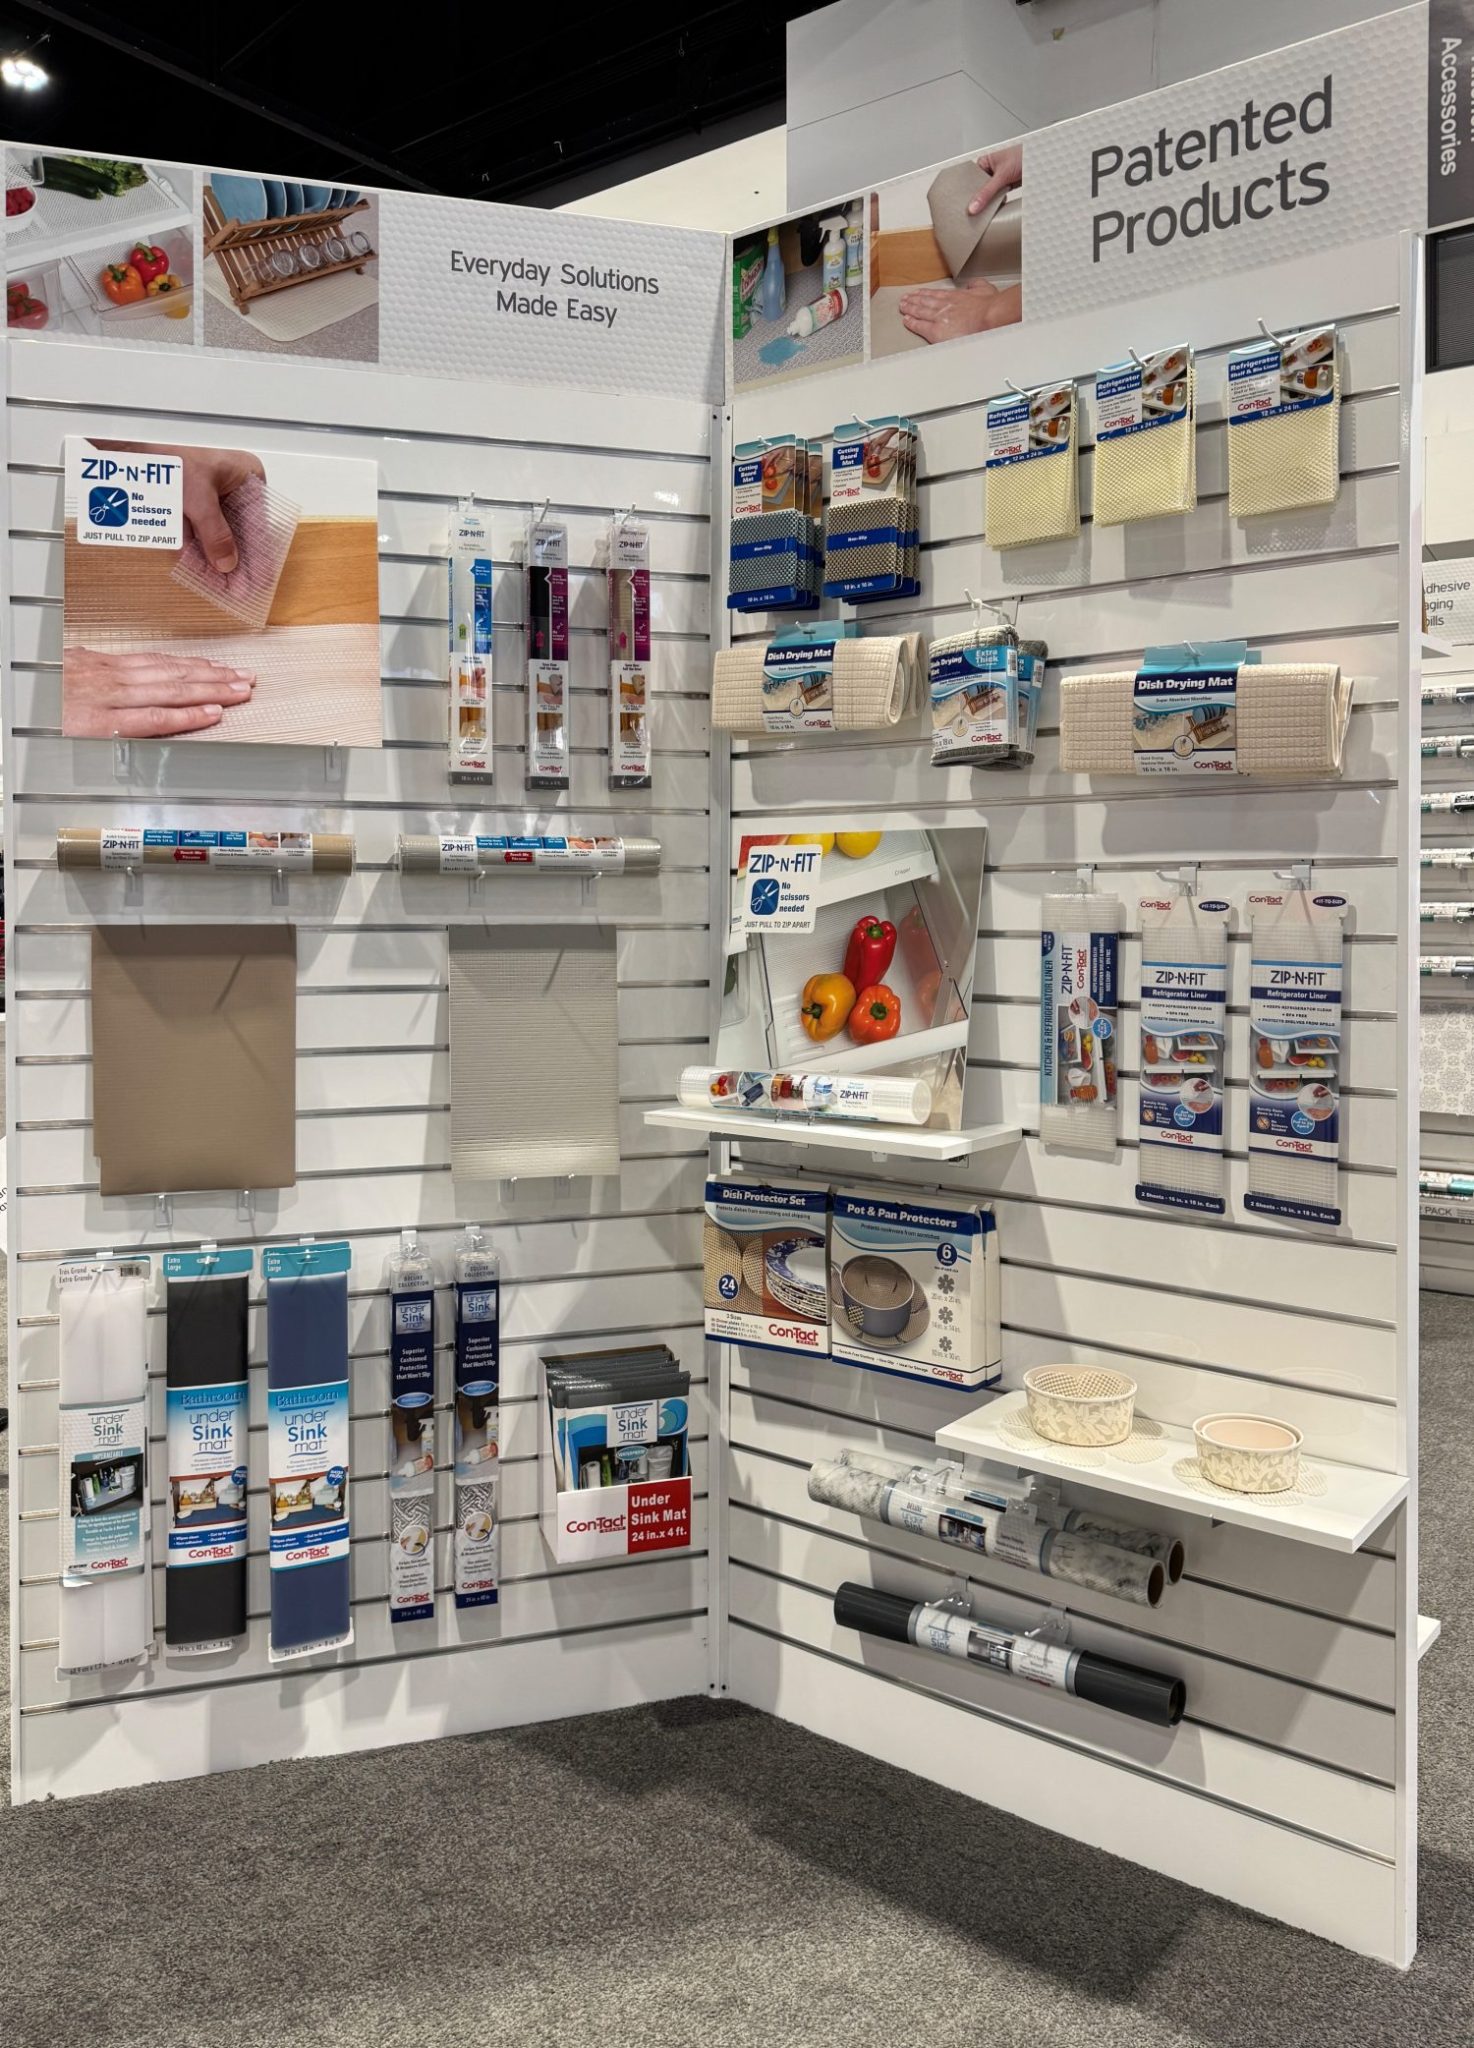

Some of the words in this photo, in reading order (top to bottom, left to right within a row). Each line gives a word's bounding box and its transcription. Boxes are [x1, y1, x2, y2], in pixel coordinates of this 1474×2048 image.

[1441, 37, 1462, 176] Accessories
[1091, 74, 1332, 198] Patented
[1093, 160, 1329, 263] Products
[451, 250, 550, 286] Everyday
[561, 264, 659, 294] Solutions
[497, 290, 557, 316] Made
[567, 299, 617, 328] Easy
[1231, 355, 1279, 371] Refrigerator
[1097, 374, 1140, 390] Refrigerator
[988, 407, 1028, 420] Refrigerator
[837, 447, 859, 455] Cutting
[840, 453, 858, 461] Board
[81, 458, 175, 484] ZIP-N-FIT
[738, 464, 758, 472] Cutting
[131, 492, 144, 500] No
[131, 505, 172, 515] scissors
[131, 518, 166, 526] needed
[105, 533, 124, 541] PULL
[151, 536, 177, 544] APART
[767, 652, 785, 660] Dish
[786, 650, 813, 660] Drying
[814, 649, 832, 658] Mat
[1138, 680, 1163, 690] Dish
[1166, 678, 1206, 690] Drying
[1208, 677, 1233, 687] Mat
[749, 853, 817, 873] ZIP-N-FIT
[1044, 960, 1053, 982] LINER
[1061, 946, 1072, 994] ZIP-N-FIT
[1156, 971, 1206, 985] ZIP-N-FIT
[1270, 970, 1325, 985] ZIP-N-FIT
[1152, 989, 1189, 999] Refrigerator
[1190, 990, 1207, 999] Liner
[1267, 990, 1308, 1000] Refrigerator
[1309, 991, 1327, 1000] Liner
[1044, 983, 1053, 1037] REFRIGERATOR
[1044, 1045, 1053, 1076] KITCHEN
[723, 1190, 742, 1199] Dish
[744, 1192, 788, 1204] Protector
[790, 1196, 806, 1205] Set
[847, 1204, 865, 1214] Pot
[867, 1206, 876, 1216] &
[877, 1208, 897, 1219] Pan
[899, 1211, 958, 1228] Protectors
[1425, 1206, 1452, 1217] PACK
[942, 1244, 952, 1259] 6
[267, 1264, 282, 1272] Large
[721, 1278, 735, 1291] 24
[466, 1294, 491, 1303] under
[400, 1304, 426, 1314] under
[468, 1302, 490, 1312] Sink
[402, 1312, 425, 1323] Sink
[468, 1336, 490, 1344] Superior
[466, 1343, 492, 1351] Cushioned
[400, 1356, 427, 1364] Cushioned
[465, 1352, 493, 1360] Protection
[487, 1359, 496, 1367] Slip
[182, 1391, 245, 1404] Bathroom
[277, 1391, 339, 1406] Bathroom
[91, 1413, 125, 1424] under
[189, 1409, 235, 1424] under
[285, 1409, 329, 1425] under
[615, 1407, 648, 1419] under
[94, 1423, 124, 1436] Sink
[193, 1423, 233, 1440] Sink
[618, 1418, 648, 1432] Sink
[288, 1423, 327, 1442] Sink
[623, 1428, 646, 1440] mat
[99, 1435, 120, 1444] mat
[199, 1438, 227, 1451] mat
[294, 1440, 323, 1452] mat
[631, 1493, 670, 1508] Under
[631, 1510, 659, 1526] Sink
[663, 1508, 687, 1521] Mat
[904, 1519, 923, 1532] Sink
[632, 1532, 645, 1542] 24
[667, 1527, 674, 1536] 4
[675, 1525, 687, 1536] ft.
[931, 1637, 951, 1649] Sink
